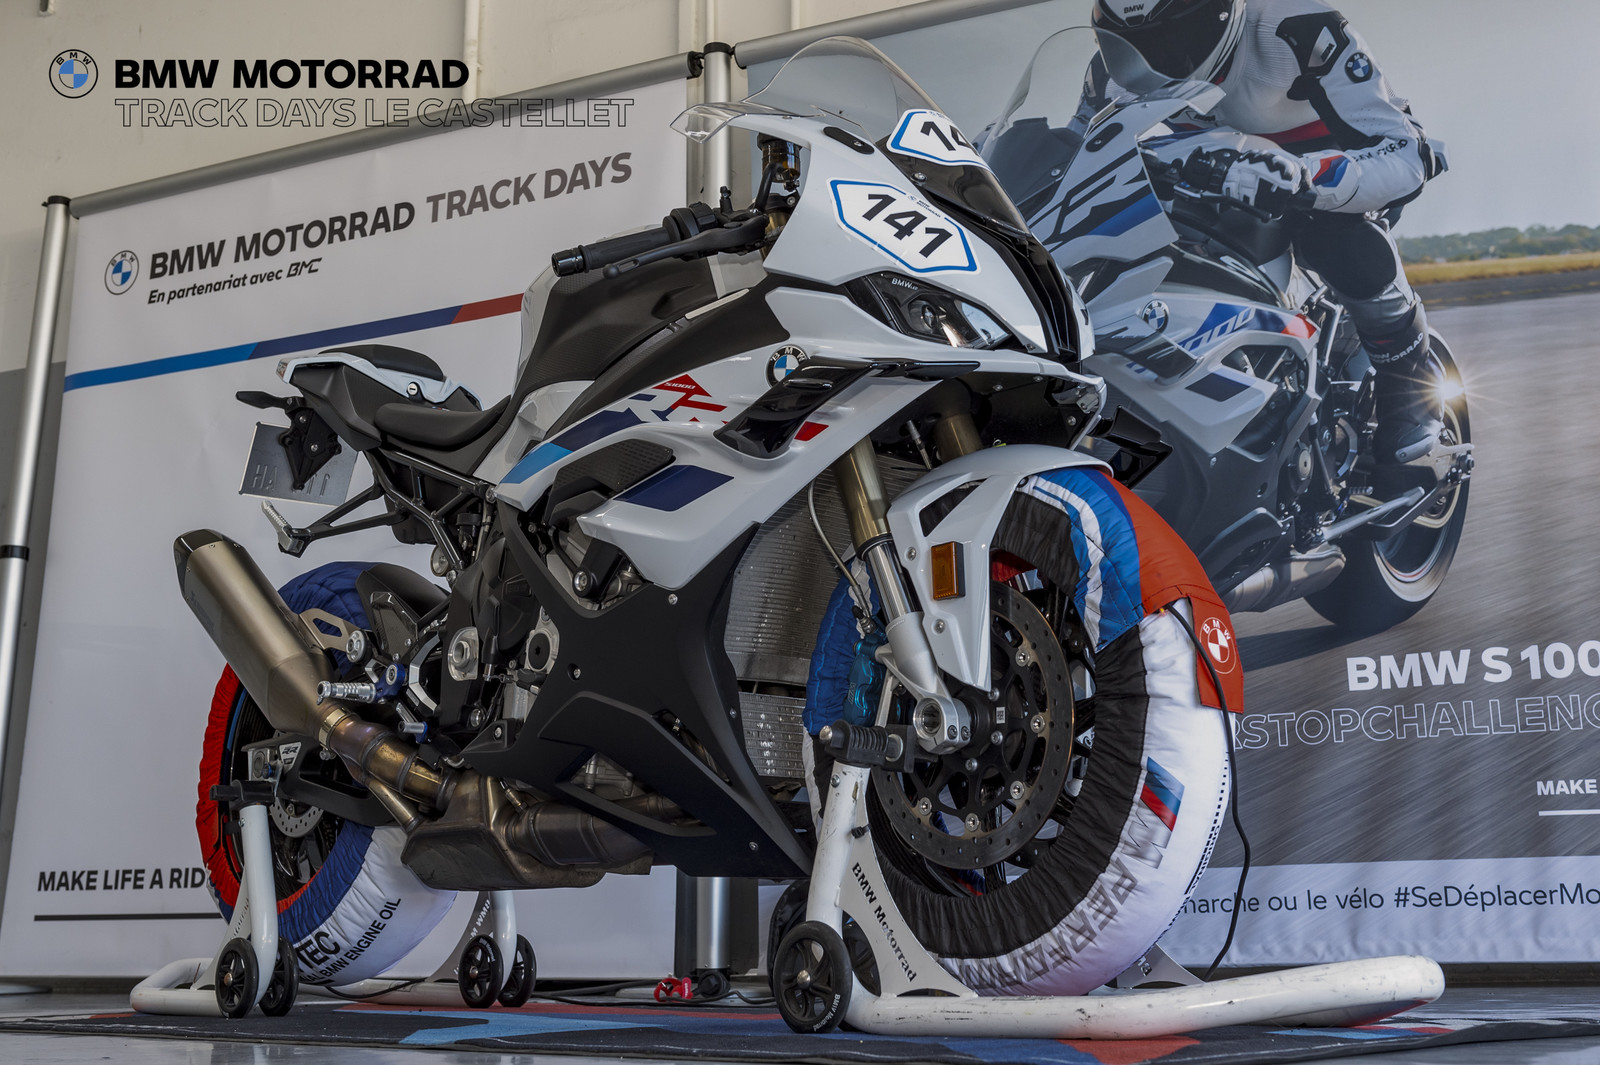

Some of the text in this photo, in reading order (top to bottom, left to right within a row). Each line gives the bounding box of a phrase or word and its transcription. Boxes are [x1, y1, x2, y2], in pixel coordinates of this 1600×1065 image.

[1123, 3, 1145, 14] BMW
[149, 152, 633, 280] BMW MOTORRAD TRACK DAYS
[862, 193, 953, 258] 141
[147, 289, 166, 305] En
[166, 273, 248, 304] partenariat
[249, 269, 283, 286] avec
[891, 277, 912, 289] BMW
[1346, 649, 1471, 692] BMW
[1481, 646, 1513, 684] S
[1537, 778, 1598, 796] MAKE
[37, 867, 206, 891] MAKE LIFE A RID
[1267, 895, 1298, 912] ou
[1307, 889, 1328, 910] le
[1335, 887, 1385, 909] vélo
[320, 956, 350, 979] BMW
[344, 919, 387, 961] ENGINE
[379, 898, 402, 920] OIL
[852, 862, 917, 982] BMW Motorrad
